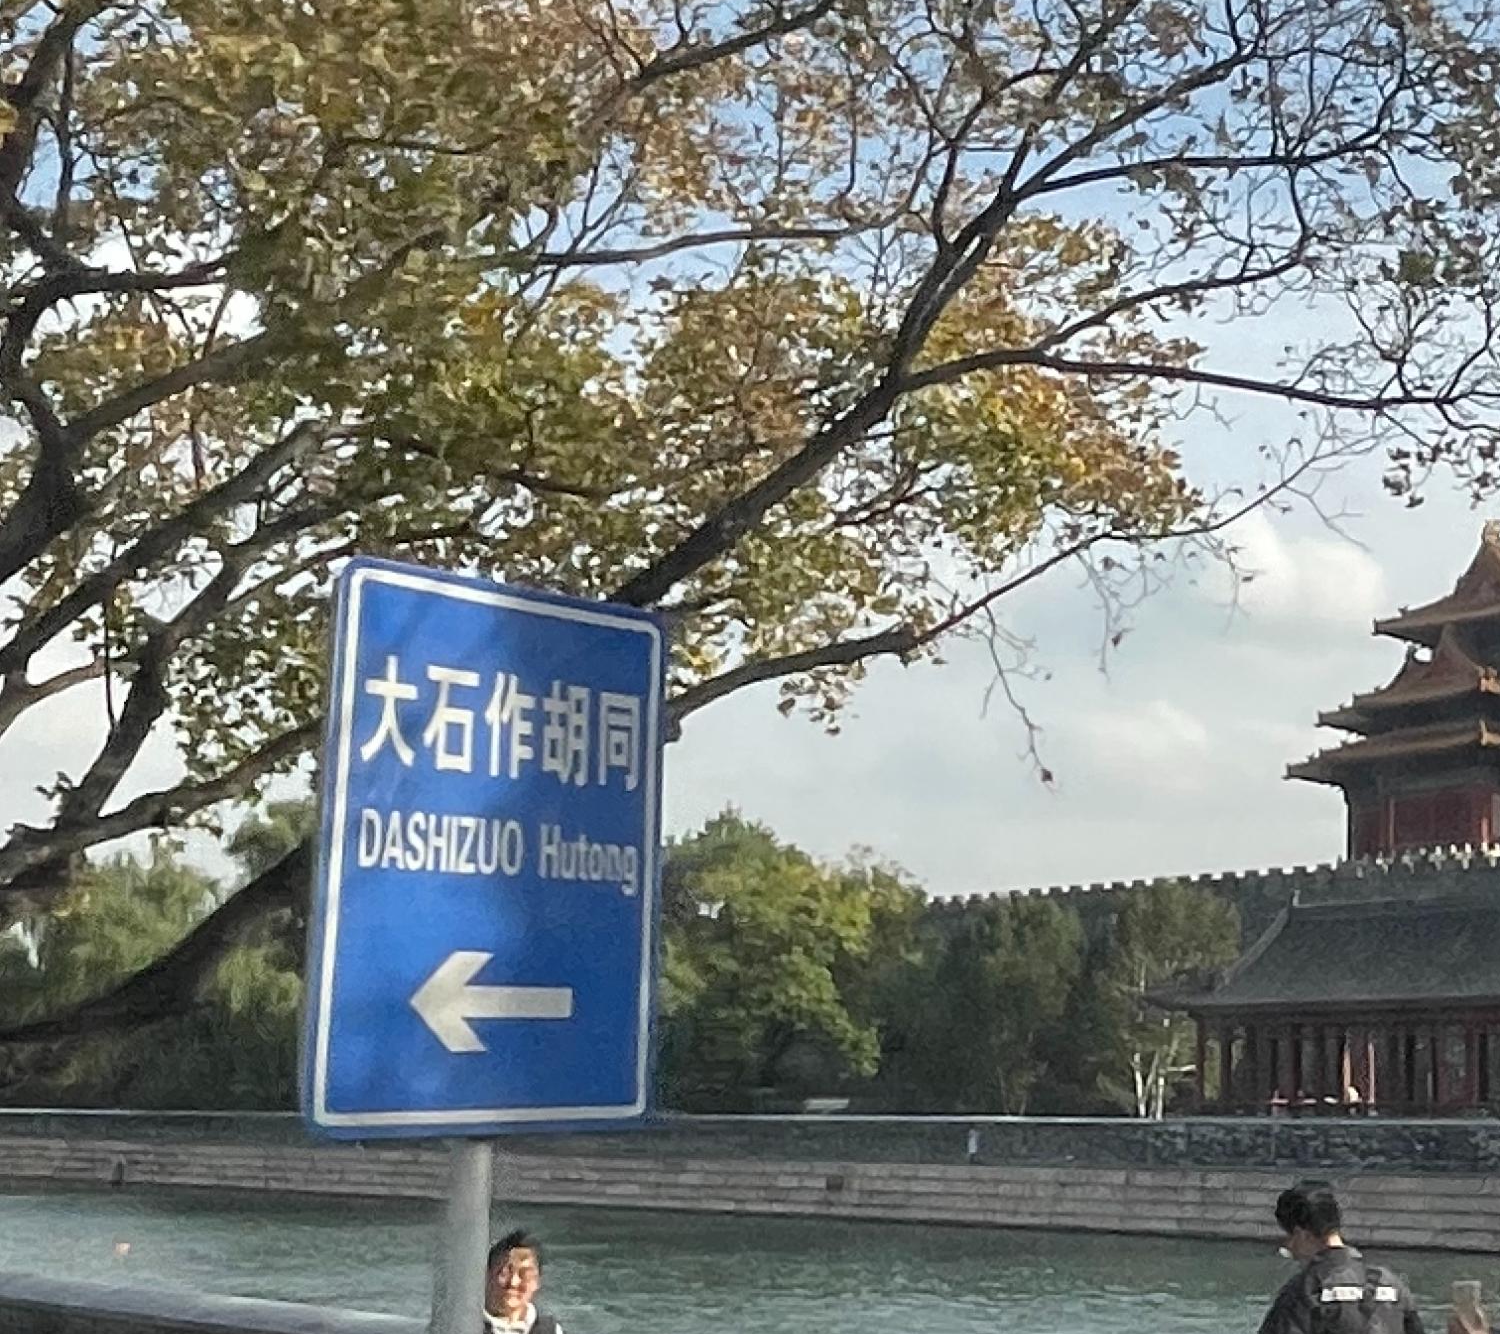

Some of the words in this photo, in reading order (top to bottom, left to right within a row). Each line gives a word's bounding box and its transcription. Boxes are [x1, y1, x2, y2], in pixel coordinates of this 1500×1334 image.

[360, 655, 640, 791] 大石作胡同
[358, 808, 524, 877] DASHIZUO
[537, 823, 639, 896] Hutong
